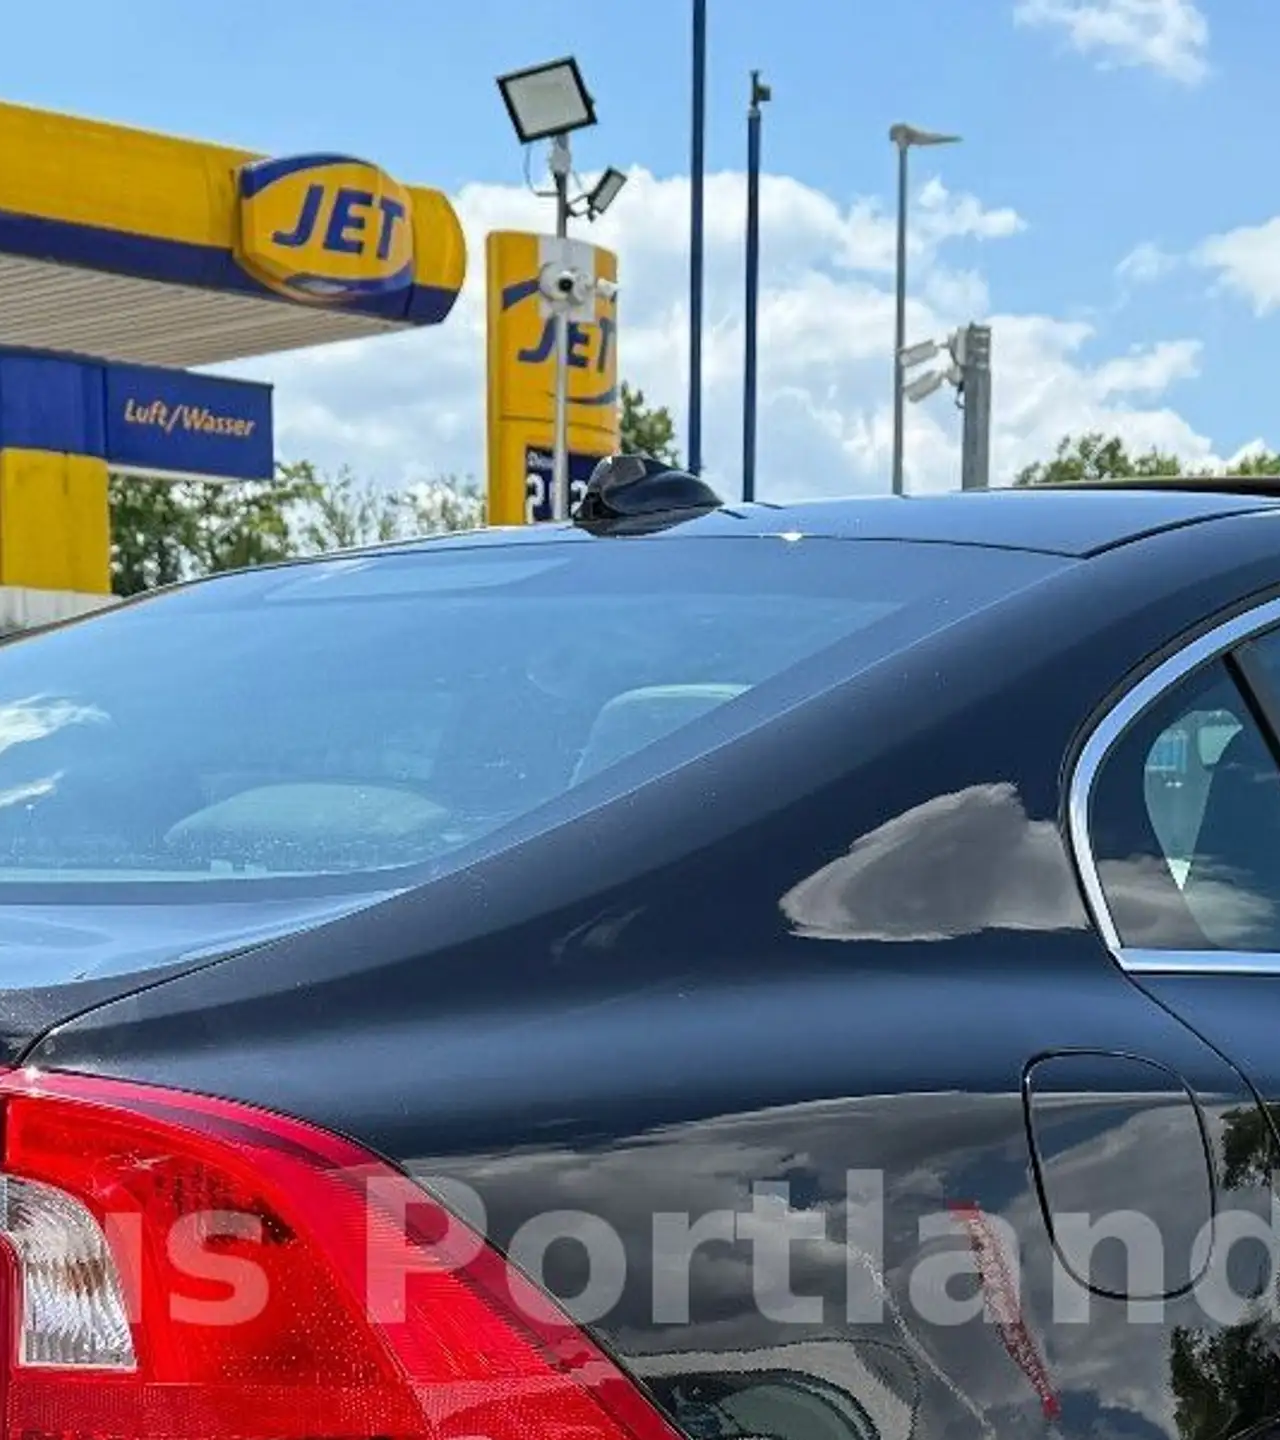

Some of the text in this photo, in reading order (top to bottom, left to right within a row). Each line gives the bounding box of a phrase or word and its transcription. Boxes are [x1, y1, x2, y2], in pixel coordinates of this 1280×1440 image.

[271, 183, 405, 261] JET
[517, 315, 616, 374] JET
[124, 398, 257, 437] Luft/Wasser
